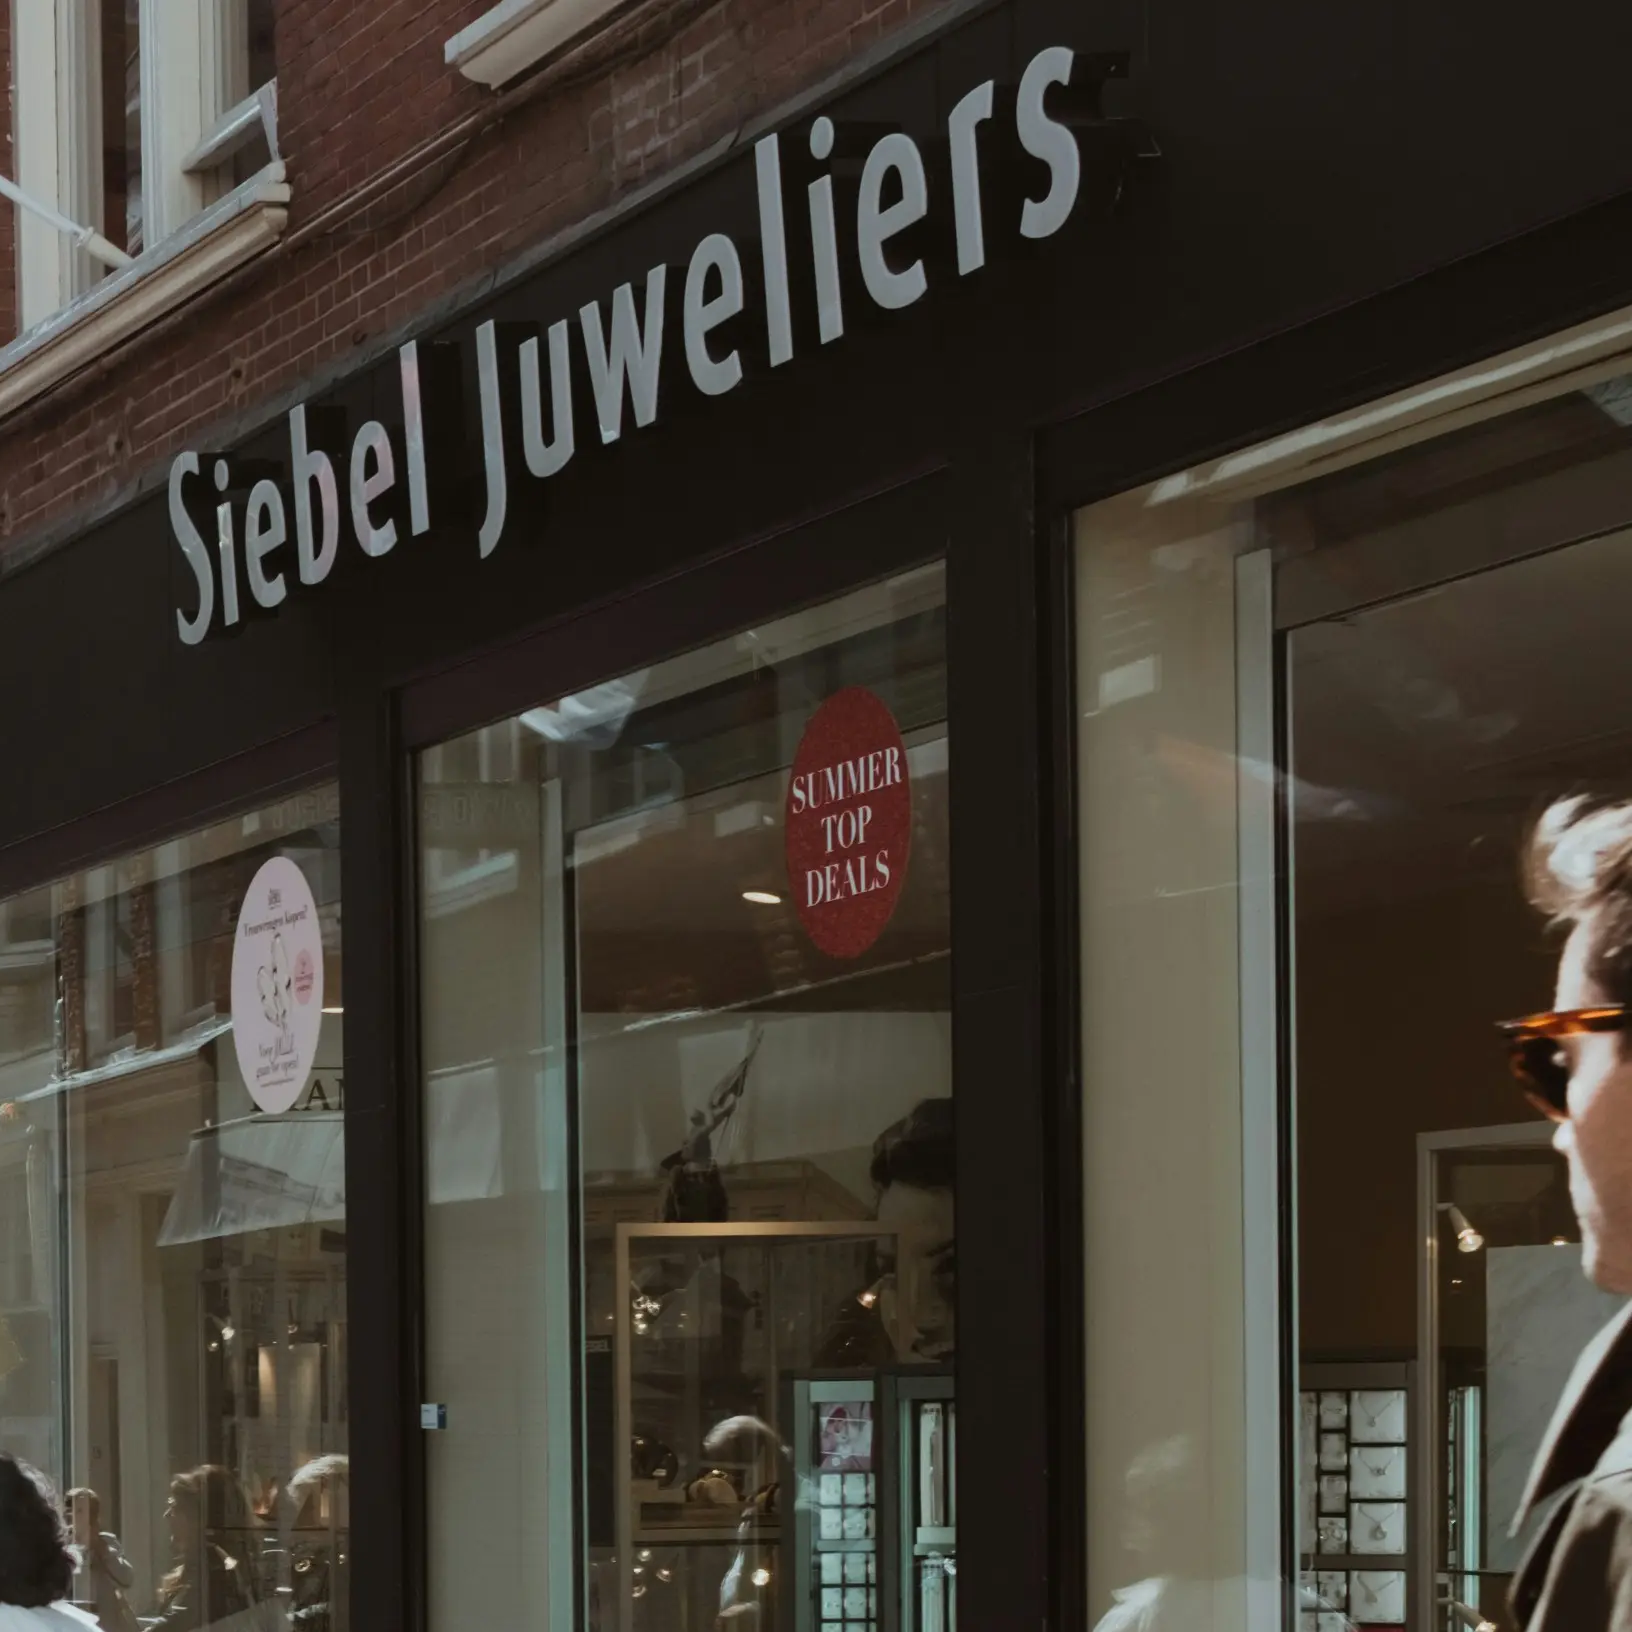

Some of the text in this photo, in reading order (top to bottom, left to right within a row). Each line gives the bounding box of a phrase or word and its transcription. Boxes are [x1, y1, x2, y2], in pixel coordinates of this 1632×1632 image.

[167, 45, 1082, 645] Siebel Juweliers
[792, 746, 902, 814] SUMMER
[821, 805, 872, 854] TOP
[805, 850, 891, 908] DEALS
